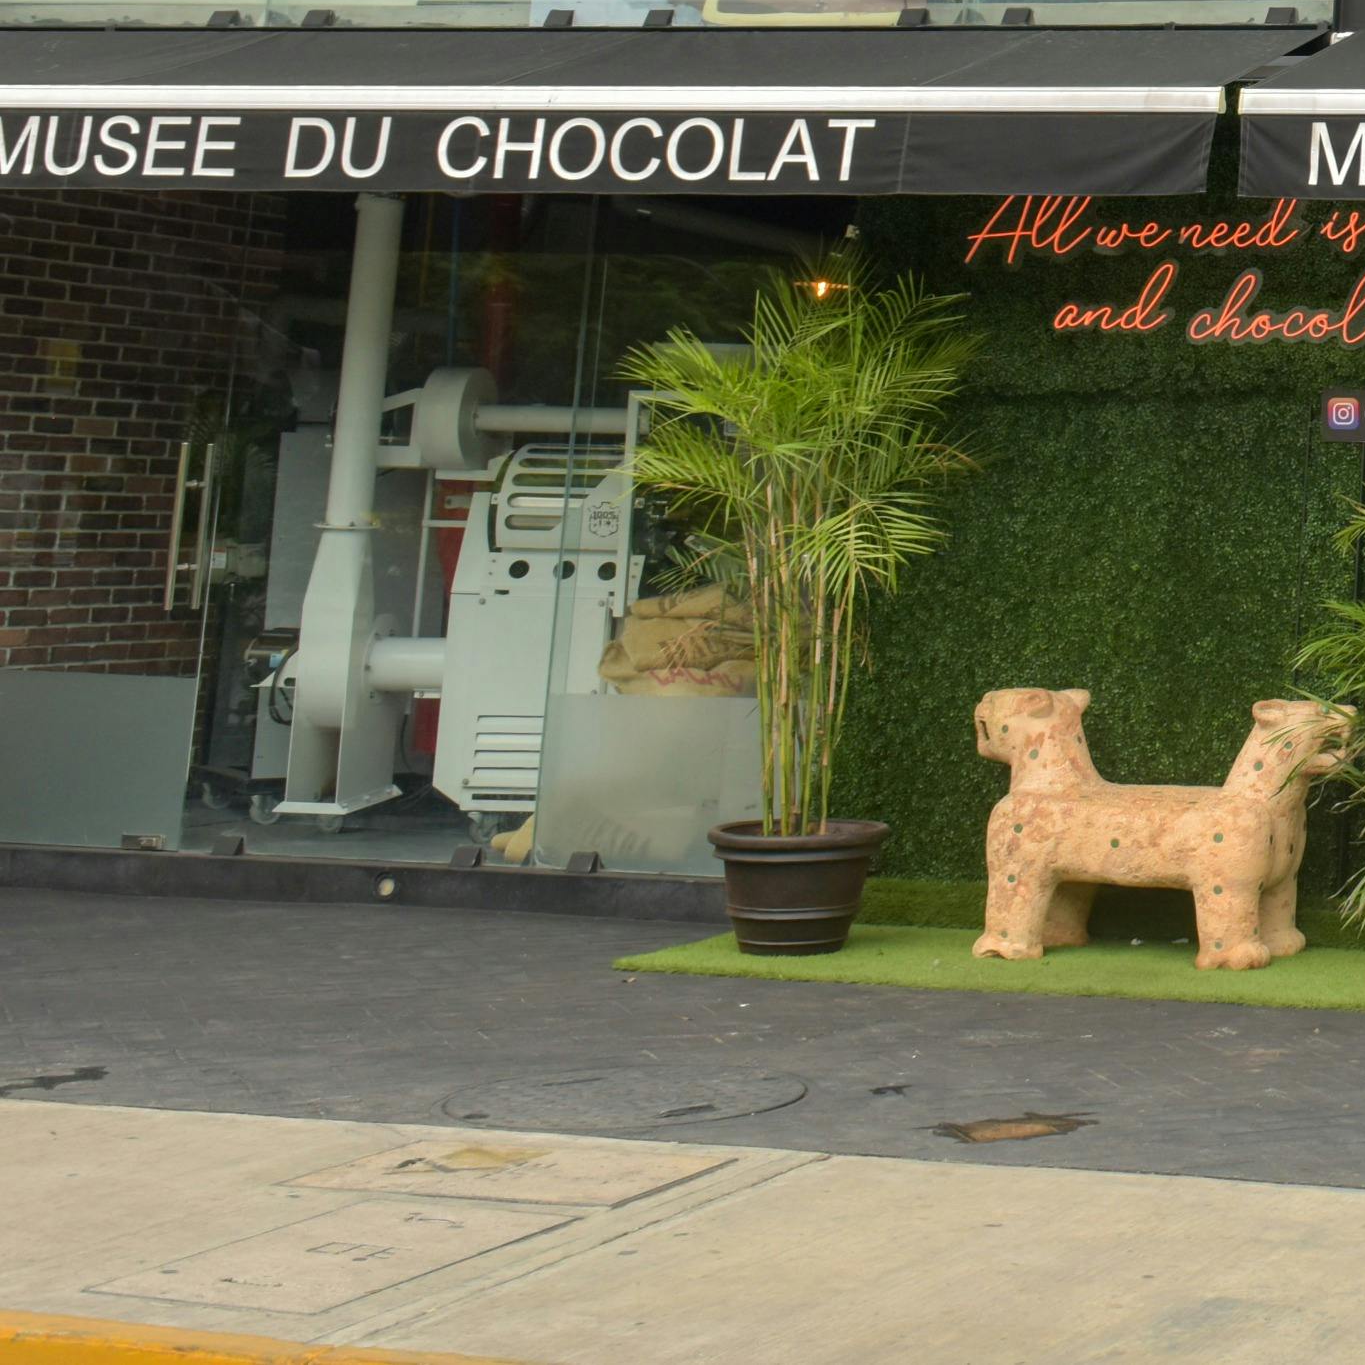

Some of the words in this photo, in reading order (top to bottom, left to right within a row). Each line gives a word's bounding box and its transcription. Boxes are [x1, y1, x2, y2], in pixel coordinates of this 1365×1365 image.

[0, 114, 242, 178] MUSEE
[283, 116, 393, 179] DU
[437, 115, 877, 182] CHOCOLAT
[964, 195, 1092, 265] All
[1096, 220, 1171, 249] we
[1179, 198, 1300, 249] need
[1052, 262, 1174, 332] and
